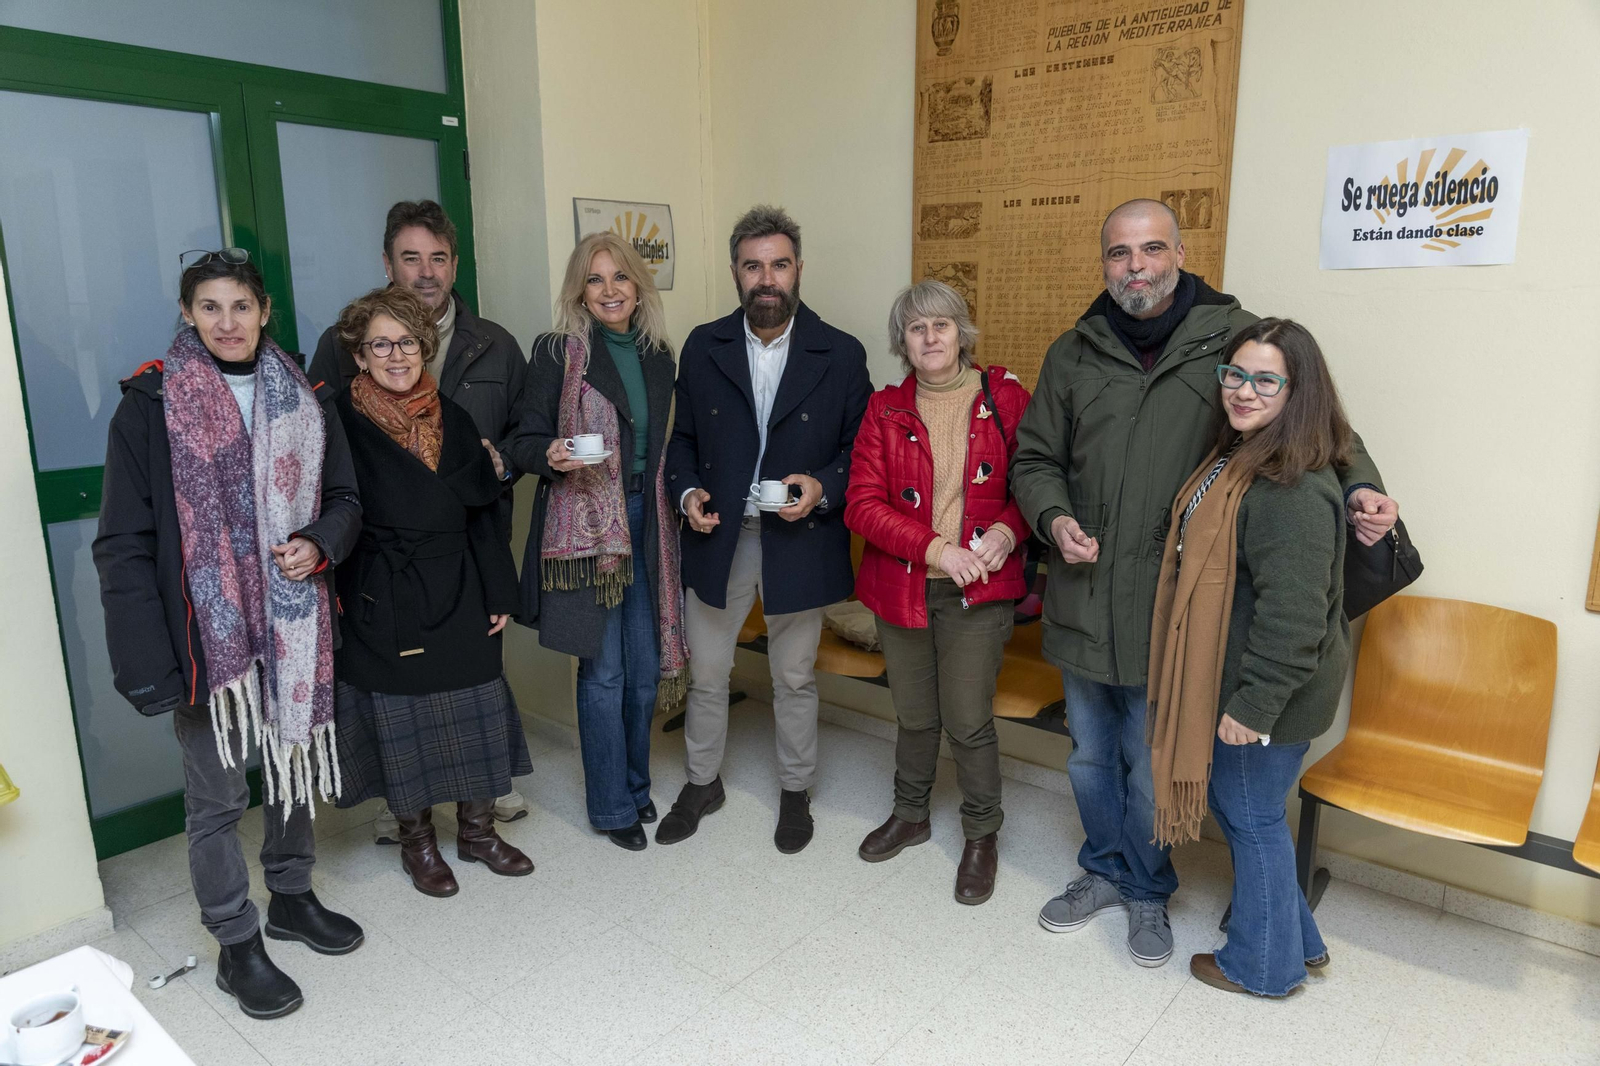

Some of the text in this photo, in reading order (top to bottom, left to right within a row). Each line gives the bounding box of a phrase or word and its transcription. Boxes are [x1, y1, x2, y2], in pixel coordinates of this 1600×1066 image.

[1046, 13, 1222, 53] LA REGION MEDITERRANEA
[1048, 21, 1092, 39] PUEBLOS
[1096, 18, 1111, 31] DE
[1114, 15, 1127, 28] LA
[1131, 1, 1209, 25] ANTIGUEDAD
[1217, 0, 1232, 10] DE
[1014, 67, 1036, 78] LOS
[1342, 167, 1499, 217] Se ruega silencio
[1352, 223, 1484, 241] Están dando clase
[633, 237, 669, 264] Múltiples 1
